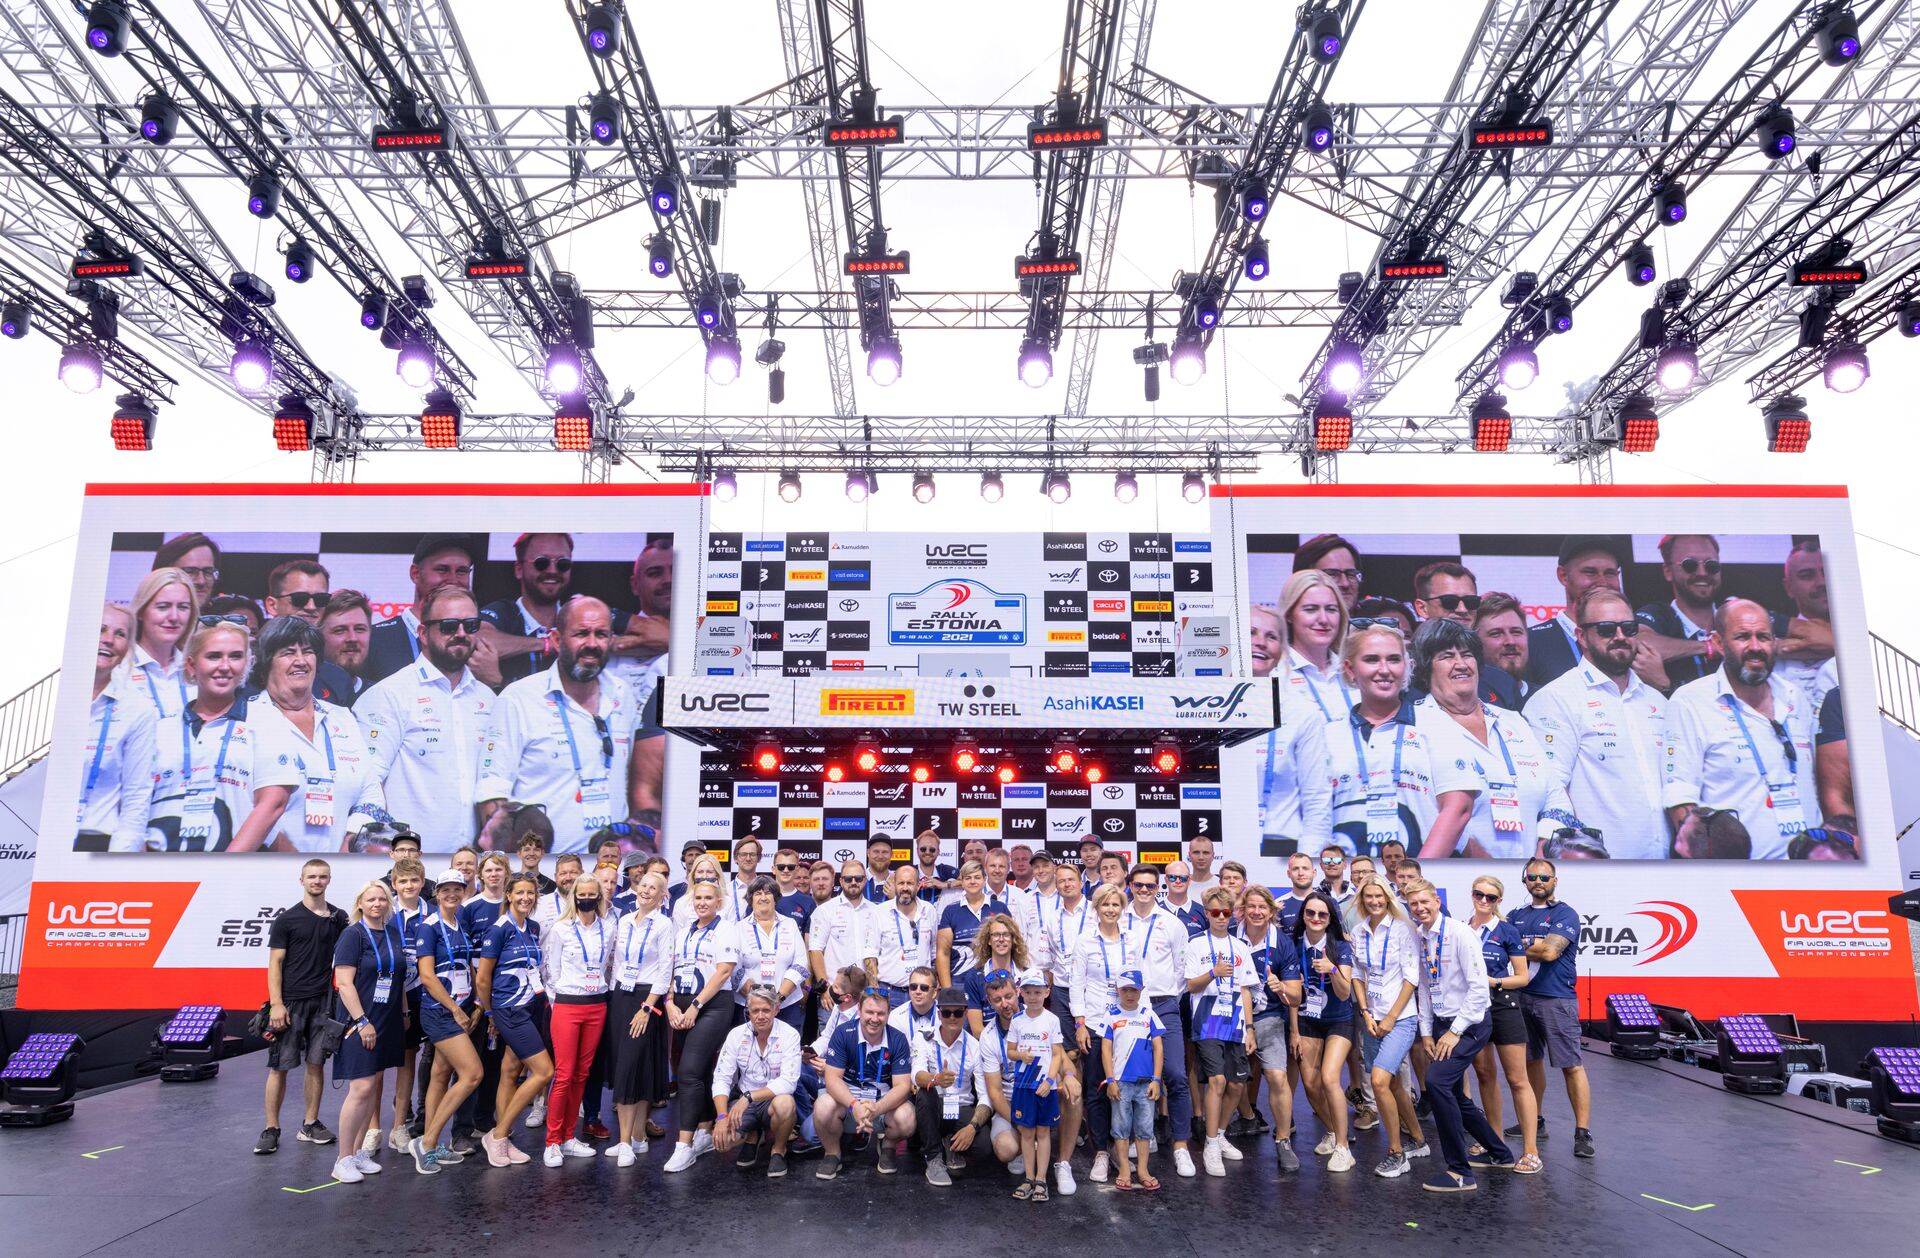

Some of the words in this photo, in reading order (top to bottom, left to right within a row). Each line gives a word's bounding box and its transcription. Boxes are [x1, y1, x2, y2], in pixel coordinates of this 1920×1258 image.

[926, 544, 988, 557] WRC
[1190, 569, 1200, 584] 3
[930, 611, 978, 619] RALLY
[907, 620, 1002, 630] ESTONIA
[753, 632, 772, 640] tsafe
[1092, 632, 1121, 640] betsafe
[681, 693, 770, 712] WRC
[829, 693, 906, 711] PIRELLI
[1043, 696, 1144, 711] AsahiKASEI
[938, 703, 963, 716] TW
[968, 703, 1022, 716] STEEL
[1176, 711, 1221, 719] LUBRICANTS
[923, 788, 947, 797] LHV
[960, 792, 974, 800] TW
[974, 792, 997, 800] STEEL
[306, 814, 334, 826] 2021
[752, 815, 761, 832] 3
[785, 820, 817, 828] PIRELLI
[930, 815, 940, 831] 3
[1011, 819, 1036, 829] LHV
[1198, 818, 1209, 834] 3
[1494, 820, 1524, 832] 2021
[1367, 831, 1399, 843] 2021
[799, 852, 820, 860] KASEI
[47, 901, 153, 925] WRC
[1780, 910, 1890, 934] WRC
[216, 937, 263, 947] 15-18
[1850, 940, 1888, 948] RALLY
[1593, 945, 1638, 956] 2021
